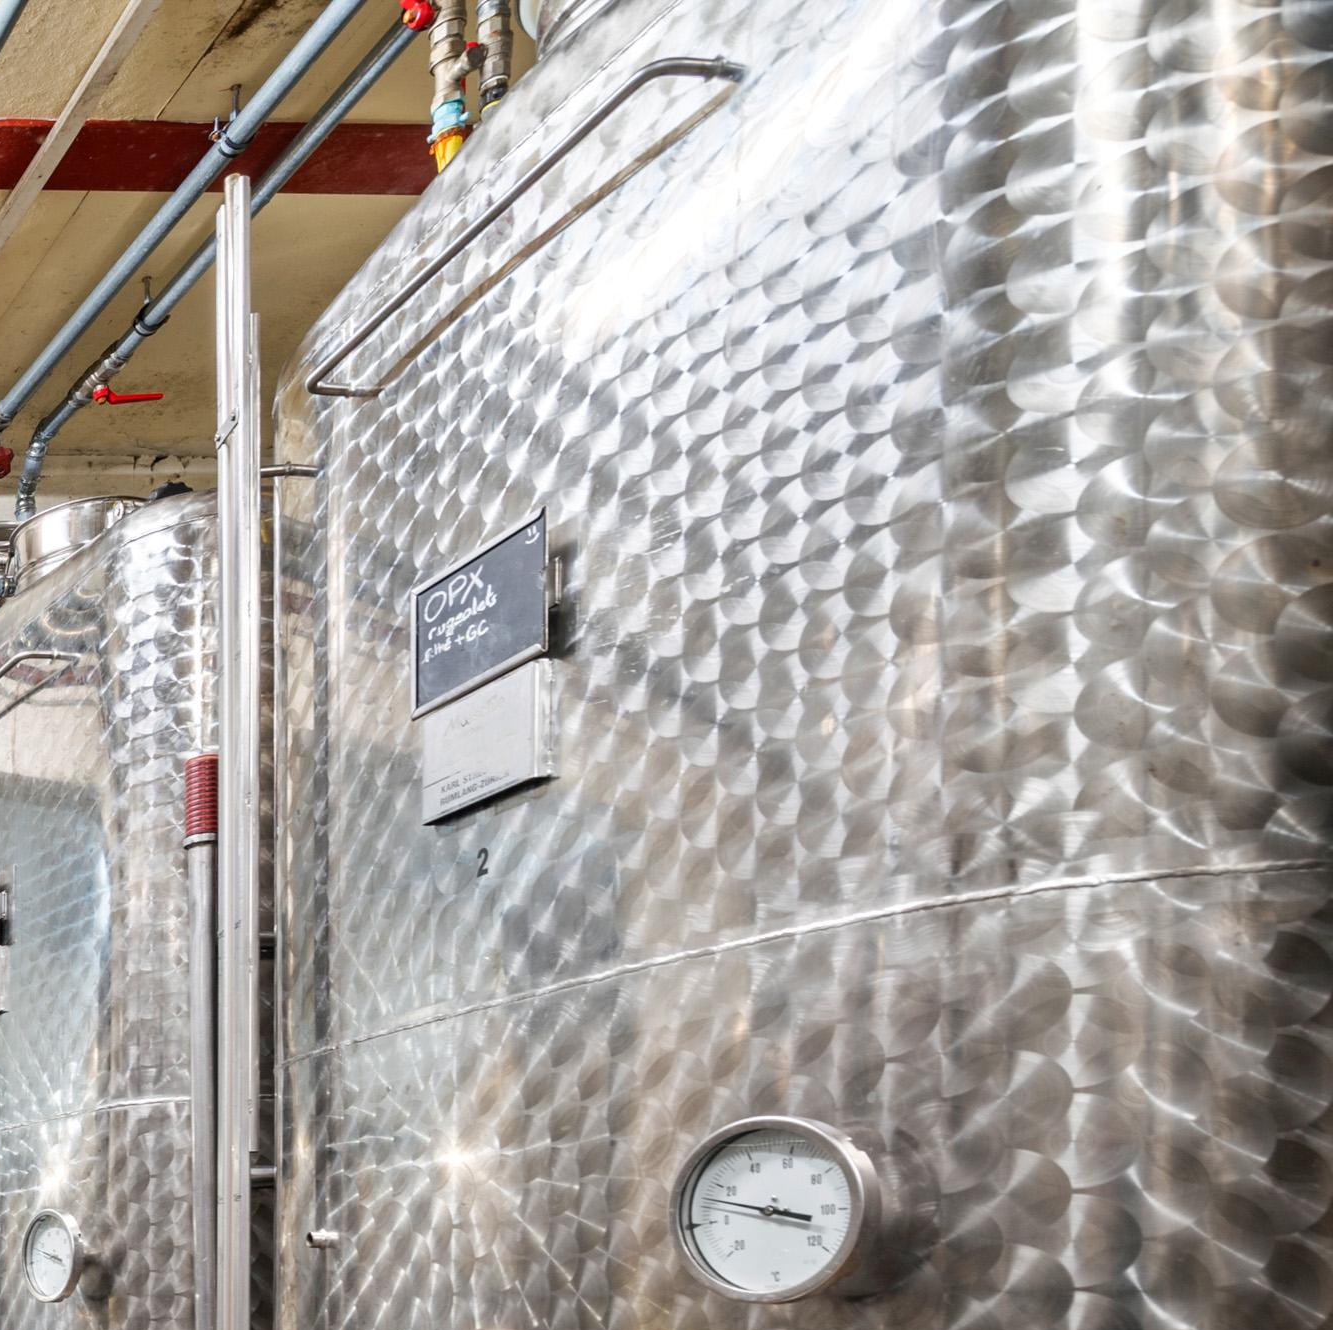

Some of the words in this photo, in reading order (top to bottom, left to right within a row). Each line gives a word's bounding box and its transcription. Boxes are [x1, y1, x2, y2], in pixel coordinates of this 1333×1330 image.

[424, 565, 484, 622] OPX
[441, 781, 459, 794] KARL
[476, 847, 489, 878] 2
[750, 1163, 761, 1174] 40
[782, 1158, 793, 1169] 60
[811, 1174, 822, 1185] 80
[726, 1186, 737, 1196] 20
[821, 1204, 836, 1215] 100
[724, 1215, 730, 1225] 0
[807, 1236, 822, 1246] 120
